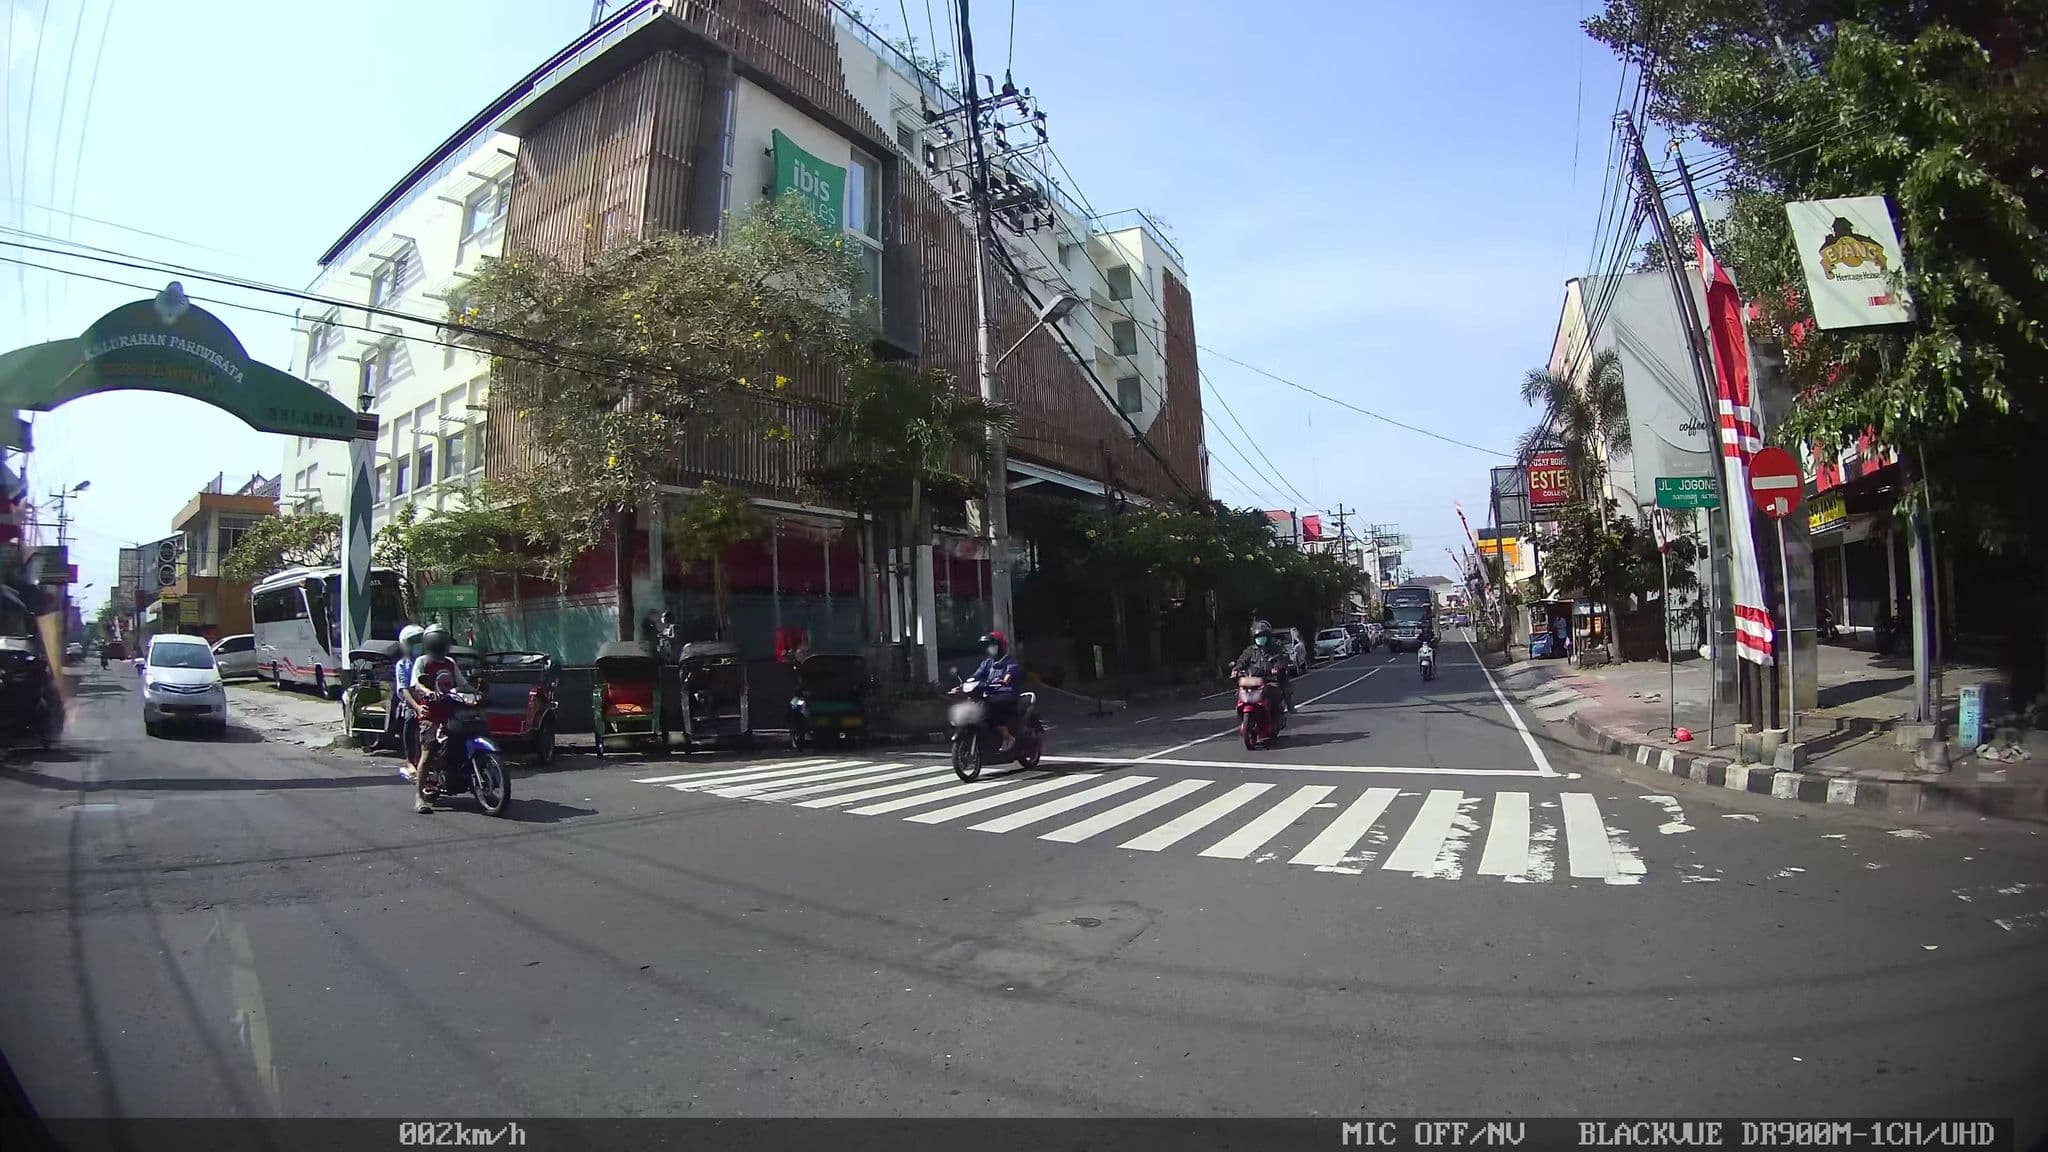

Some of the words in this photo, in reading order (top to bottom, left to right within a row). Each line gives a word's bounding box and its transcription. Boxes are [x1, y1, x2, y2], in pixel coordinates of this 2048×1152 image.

[793, 159, 830, 202] ibis
[170, 335, 244, 384] PARIWISATA
[1658, 480, 1672, 491] JL
